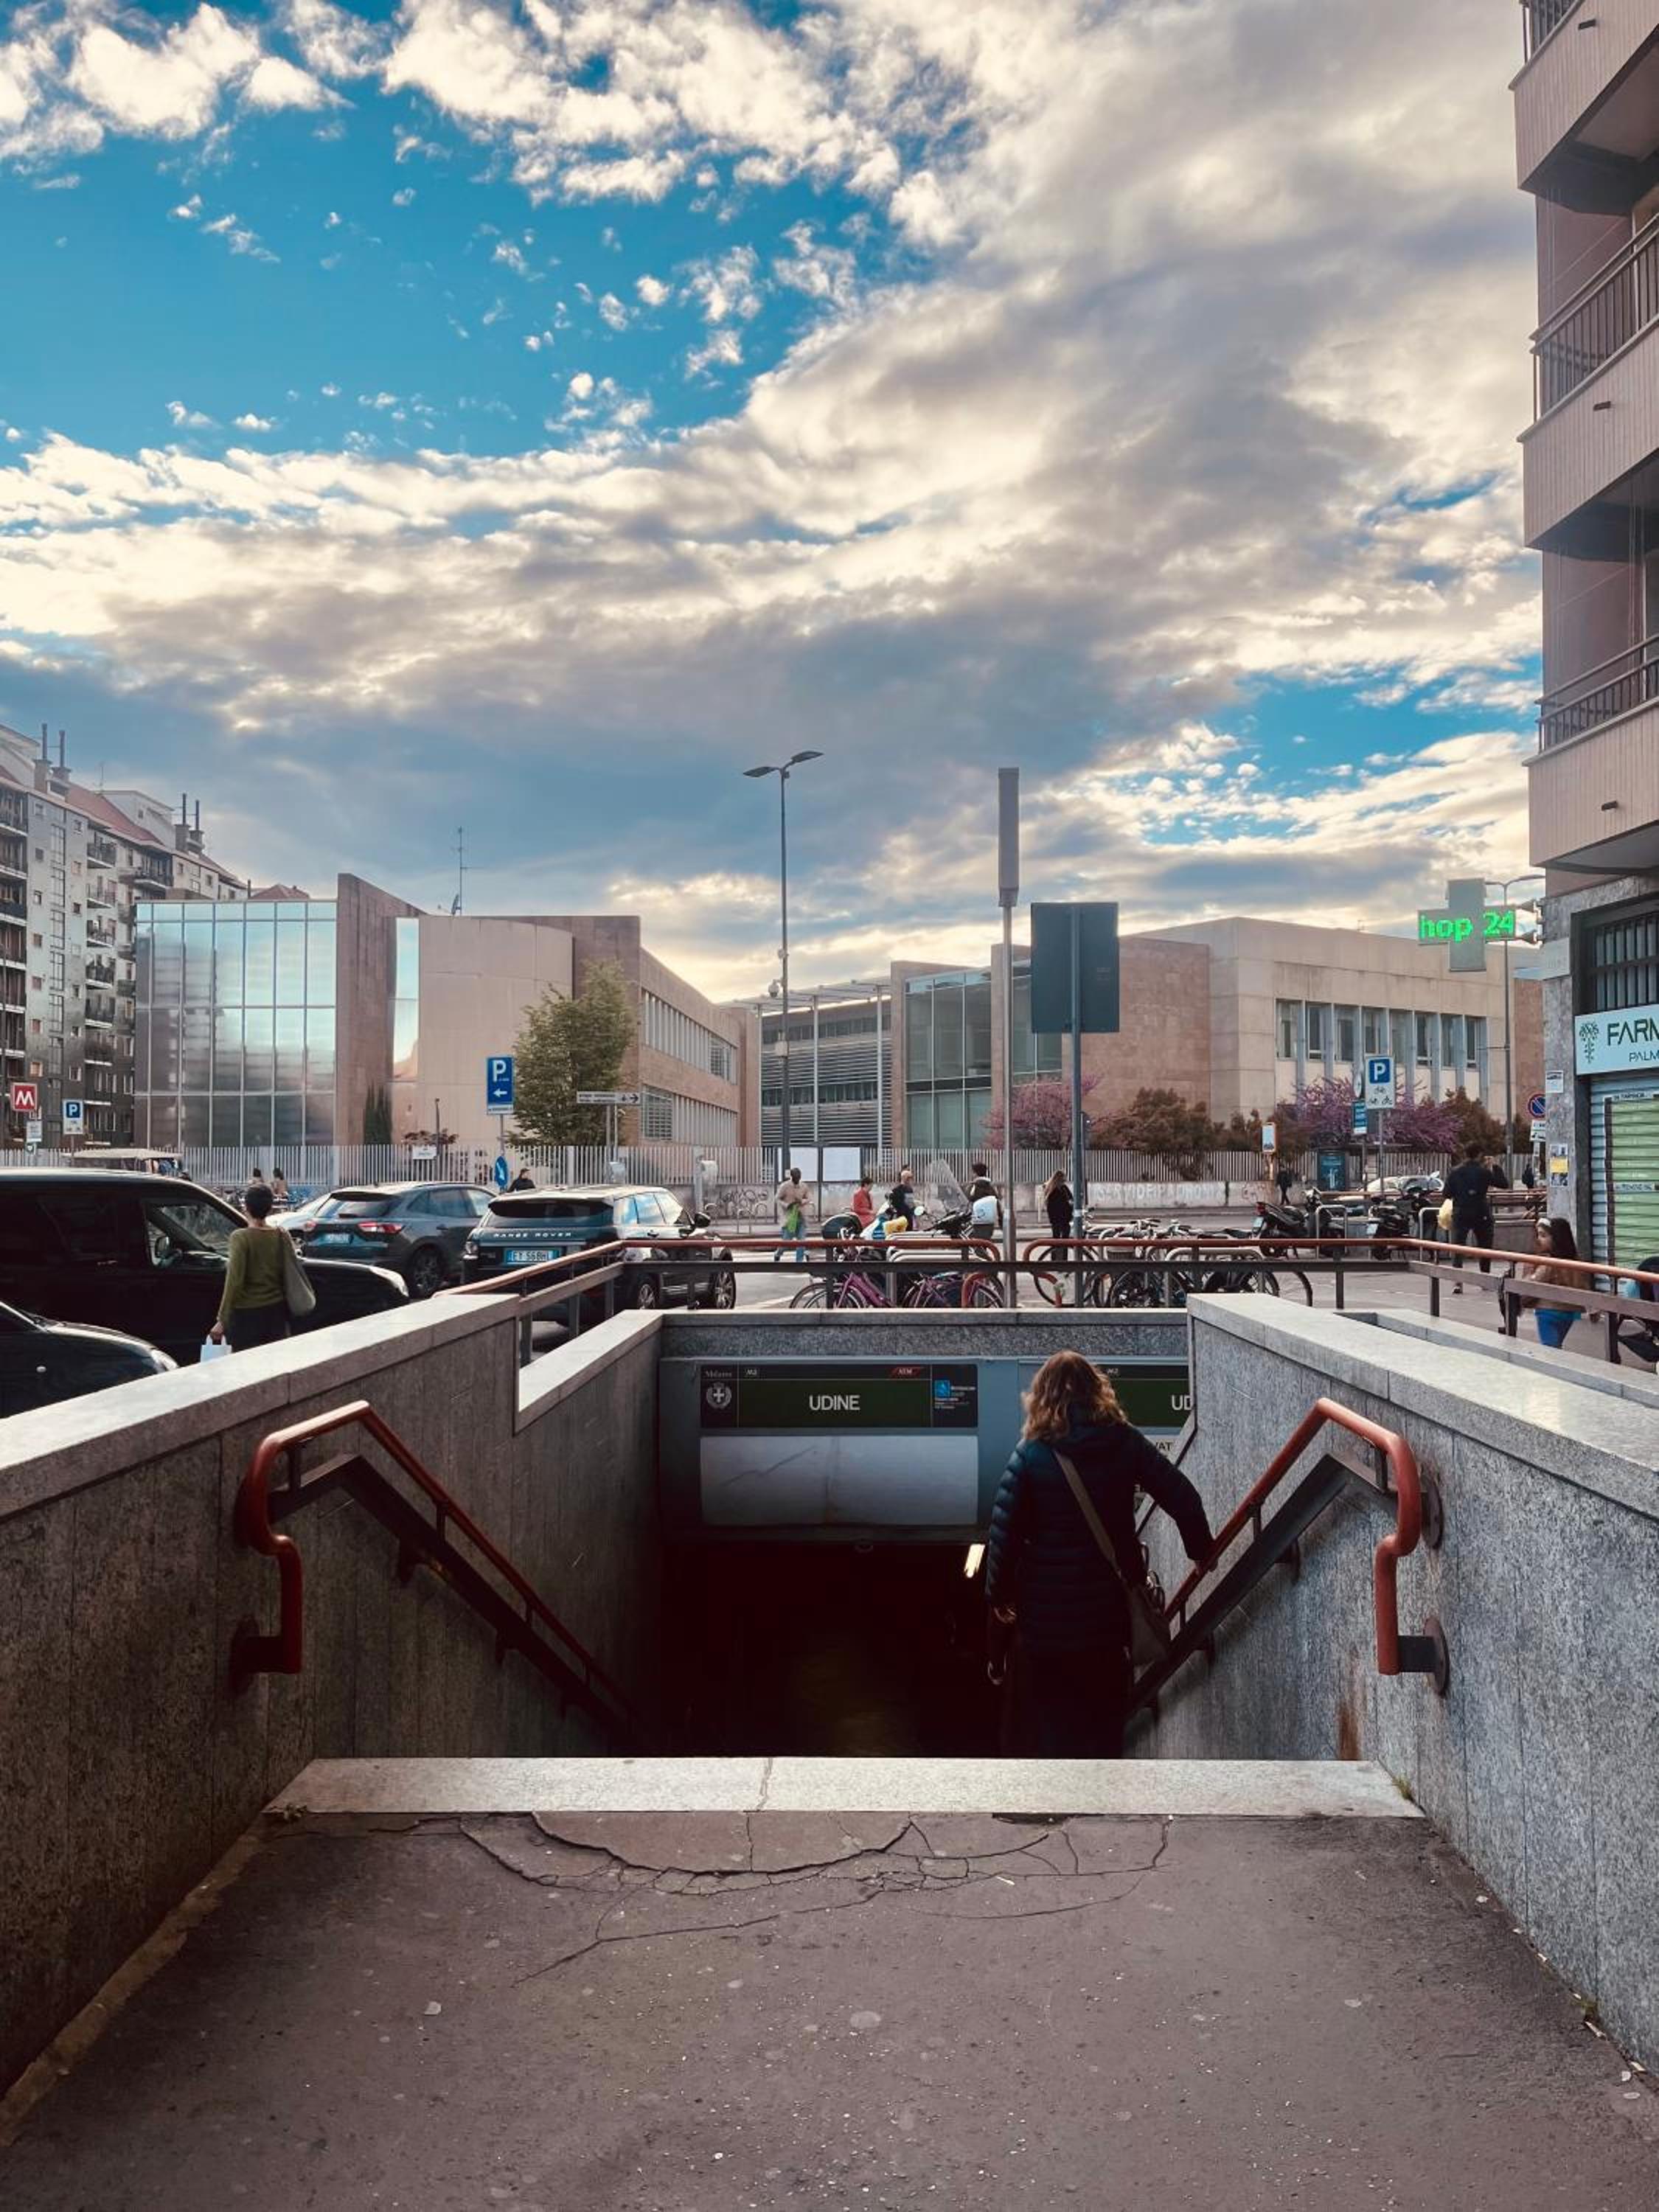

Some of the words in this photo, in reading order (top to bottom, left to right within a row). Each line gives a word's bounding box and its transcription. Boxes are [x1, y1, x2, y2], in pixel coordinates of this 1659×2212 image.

[1419, 915, 1472, 942] hop
[1484, 910, 1514, 936] 24
[493, 1060, 507, 1082] P
[1374, 1062, 1386, 1081] P
[15, 1090, 35, 1106] M
[69, 1104, 78, 1116] P
[809, 1394, 860, 1411] UDINE
